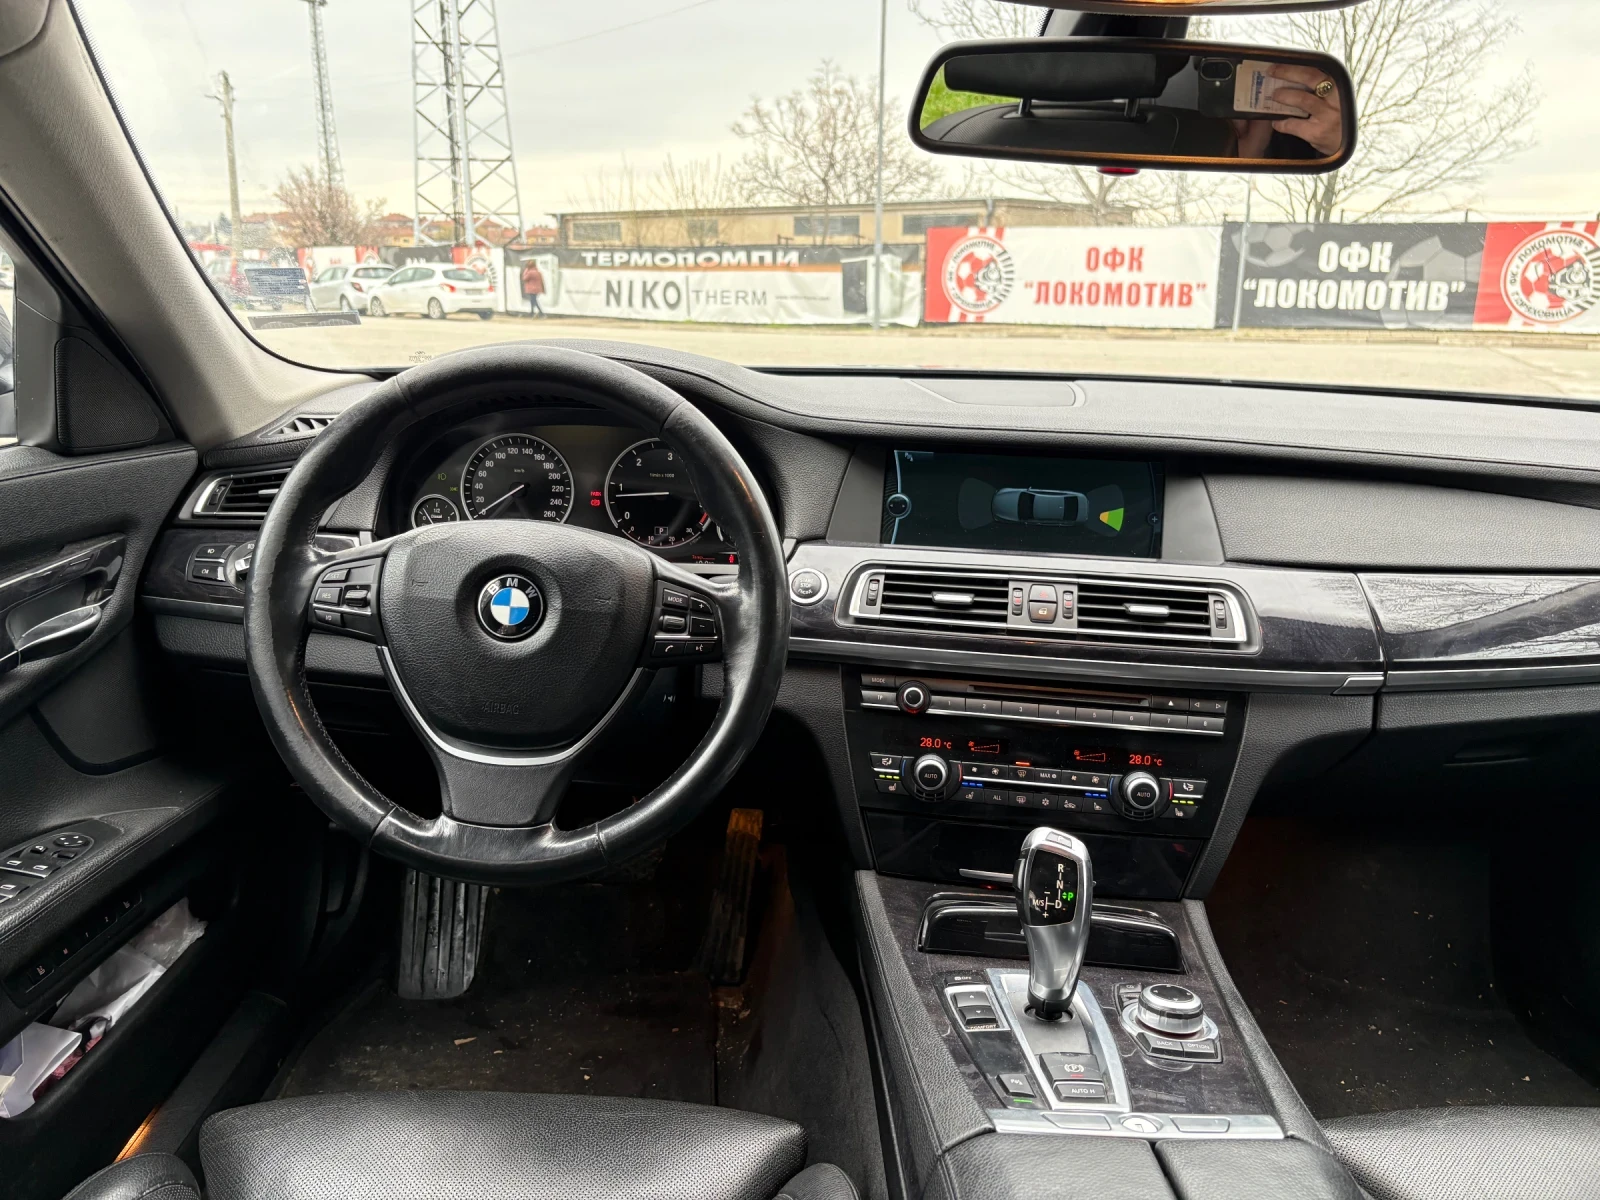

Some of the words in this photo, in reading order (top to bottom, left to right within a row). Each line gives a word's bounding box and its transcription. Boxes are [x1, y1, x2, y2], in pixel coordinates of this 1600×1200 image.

[581, 251, 800, 268] ТЕРМОПОМПИ
[1086, 247, 1144, 273] ОФК
[1318, 241, 1392, 273] ОФК
[605, 279, 682, 311] NIKO
[691, 289, 767, 306] THERM
[487, 578, 538, 598] BMW
[481, 702, 519, 714] AIRBAG
[920, 737, 941, 748] 28.0
[1129, 754, 1151, 766] 28.0
[1058, 864, 1064, 872] R
[1056, 880, 1063, 889] N
[1068, 893, 1074, 901] P
